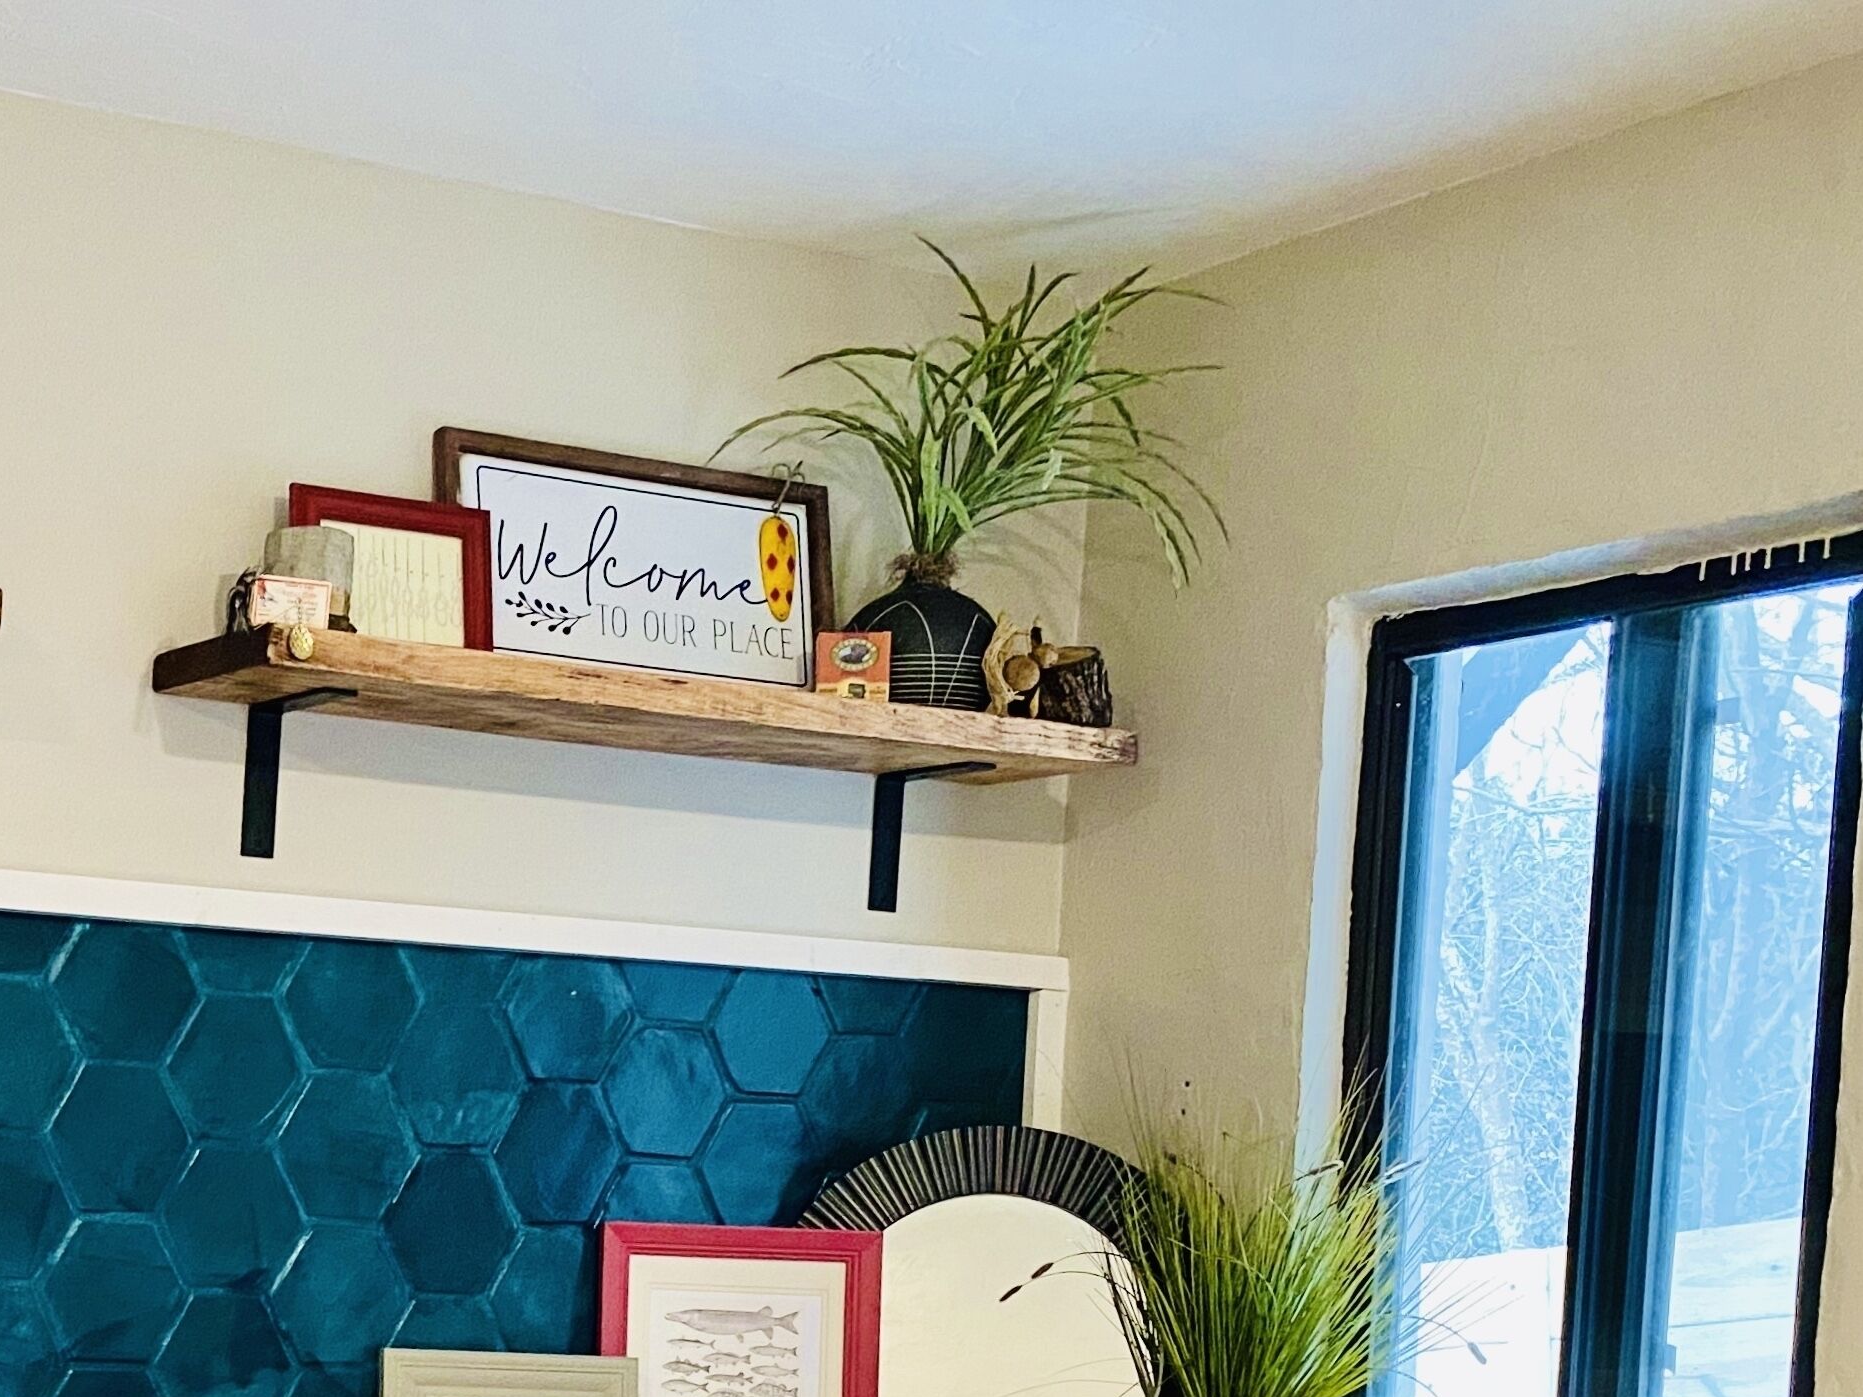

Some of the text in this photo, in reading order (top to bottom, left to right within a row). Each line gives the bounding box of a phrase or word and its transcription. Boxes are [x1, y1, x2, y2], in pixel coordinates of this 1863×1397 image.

[497, 504, 770, 606] Welcome
[595, 603, 628, 639] TO
[642, 609, 698, 648] OUR
[712, 618, 795, 660] PLACE
